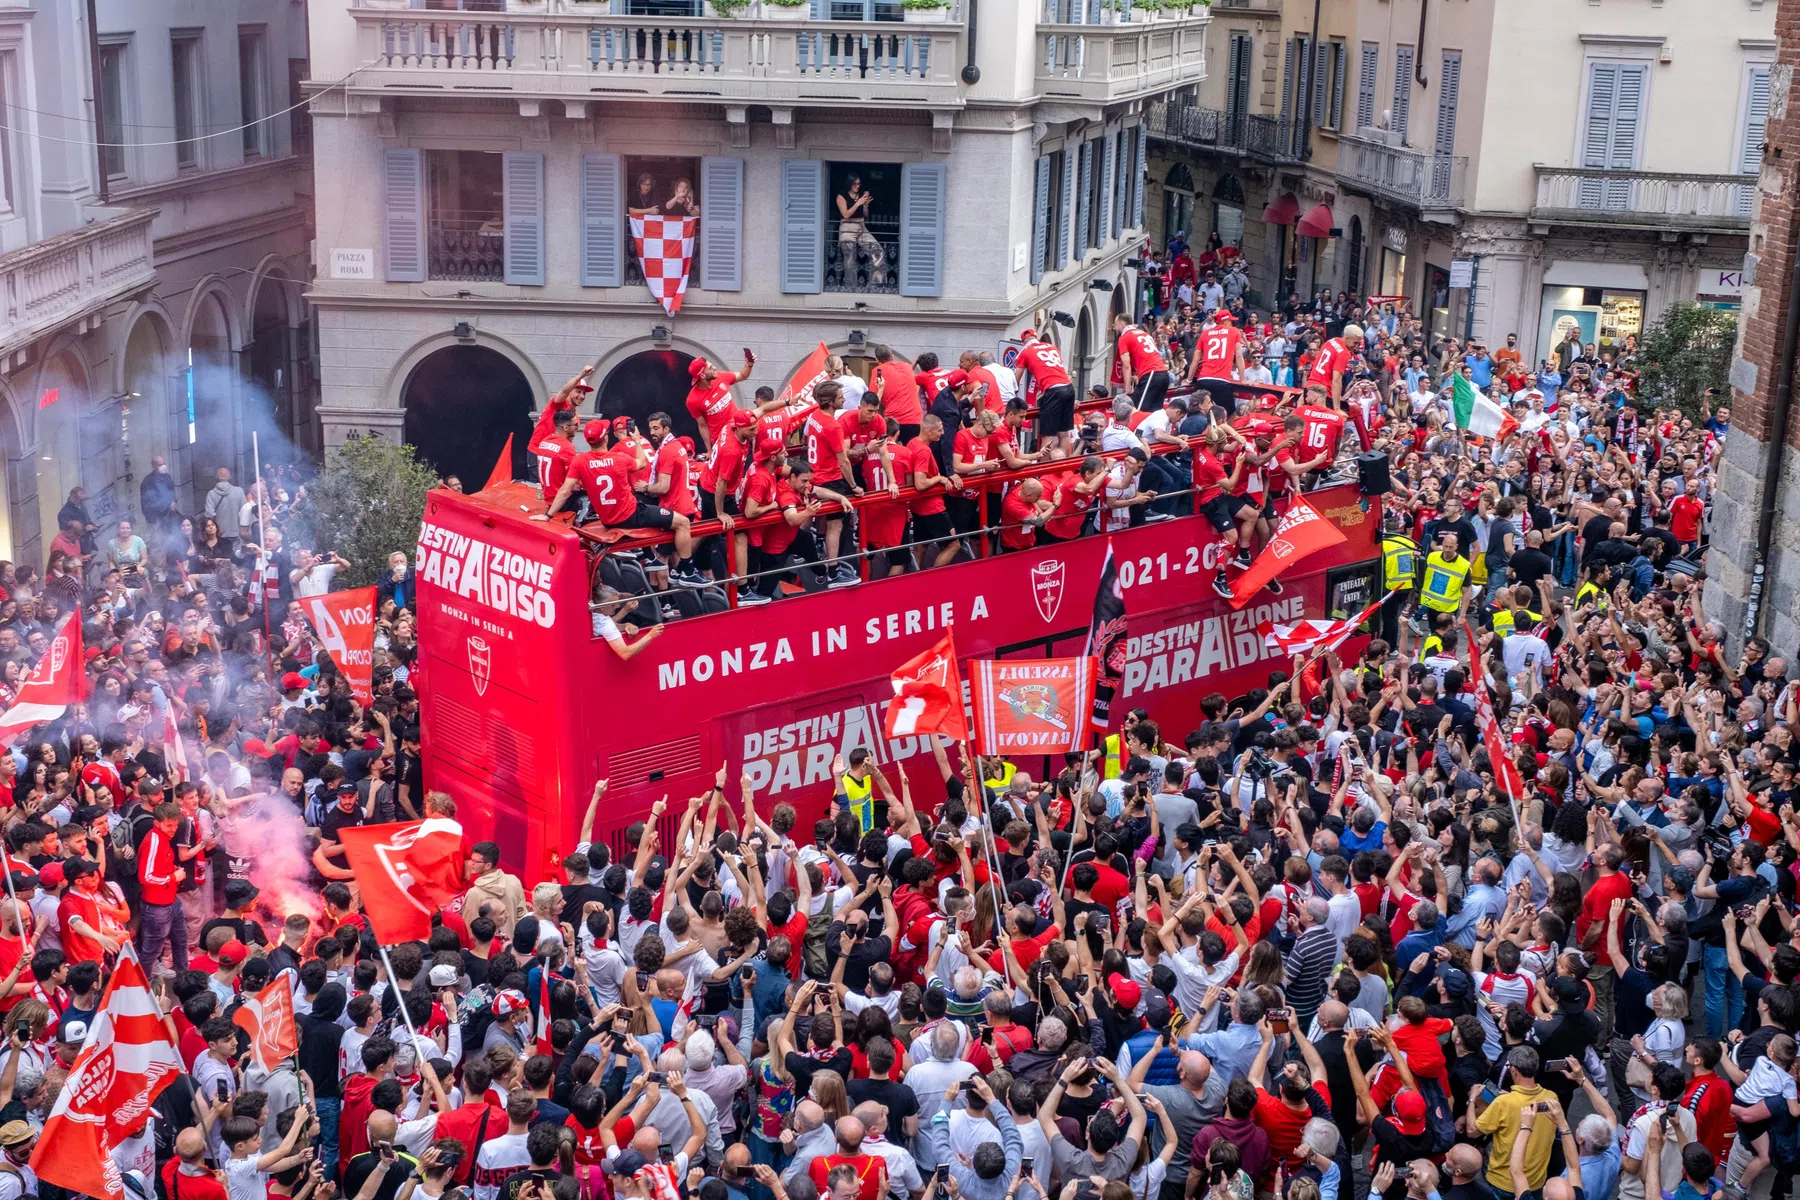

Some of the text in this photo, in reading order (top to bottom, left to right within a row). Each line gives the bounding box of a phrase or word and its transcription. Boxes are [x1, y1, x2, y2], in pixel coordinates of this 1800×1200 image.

[337, 253, 366, 262] PIAZZA
[340, 265, 364, 274] ROMA
[1718, 271, 1742, 287] KI
[1207, 337, 1229, 359] 21
[1307, 422, 1328, 448] 16
[808, 434, 818, 464] 8
[590, 457, 614, 469] DONATI
[596, 474, 617, 505] 2
[441, 604, 514, 640] MONZA IN SERIE A
[657, 595, 990, 691] MONZA IN SERIE A
